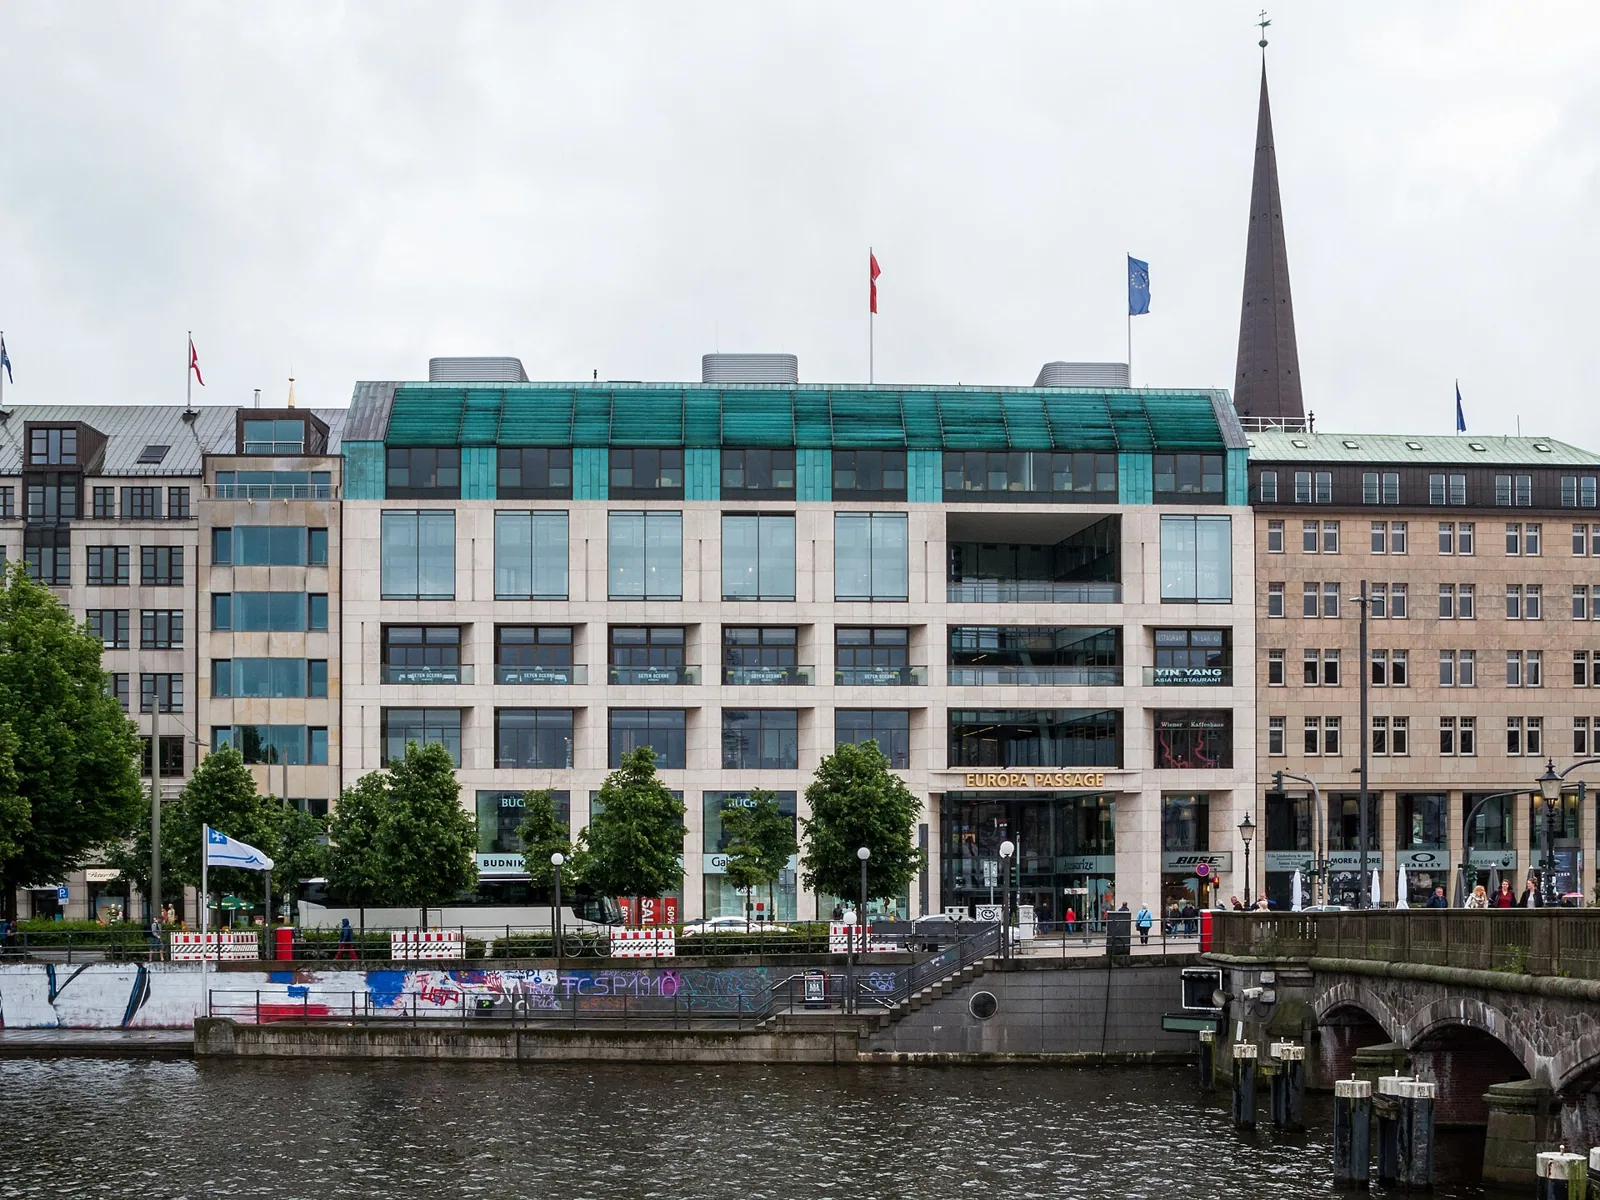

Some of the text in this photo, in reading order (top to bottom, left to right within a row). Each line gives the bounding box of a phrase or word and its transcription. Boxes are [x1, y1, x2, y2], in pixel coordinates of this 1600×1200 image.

[965, 773, 1105, 788] EUROPA PASSAGE
[502, 796, 526, 808] BÜC
[1169, 855, 1225, 864] BOSE
[60, 888, 66, 898] P
[641, 899, 654, 925] SAL
